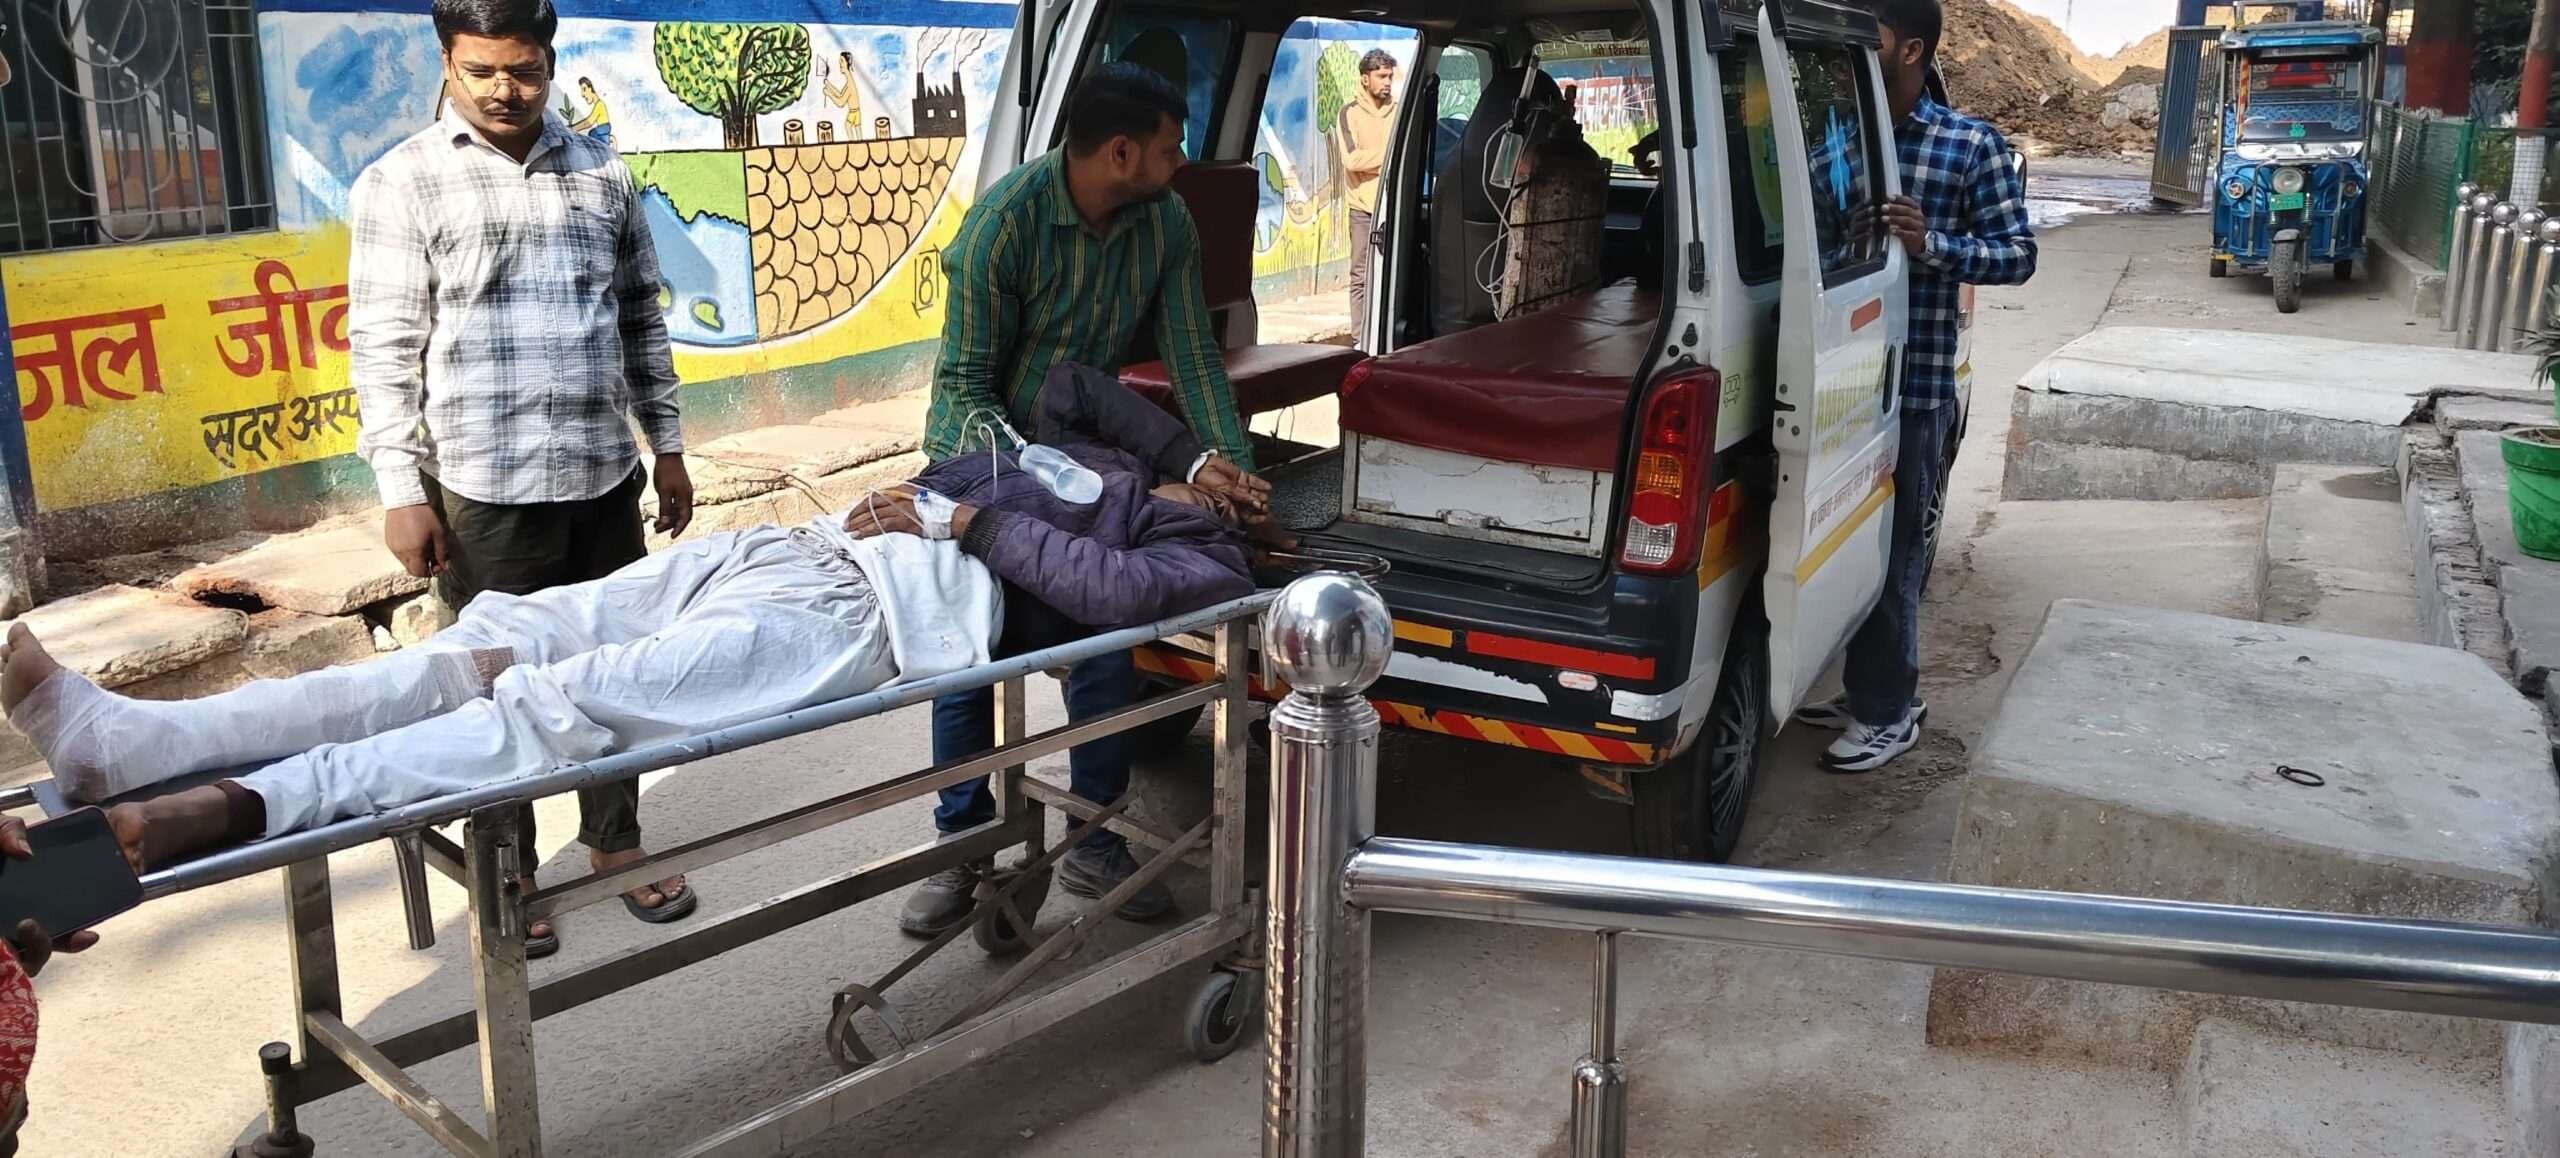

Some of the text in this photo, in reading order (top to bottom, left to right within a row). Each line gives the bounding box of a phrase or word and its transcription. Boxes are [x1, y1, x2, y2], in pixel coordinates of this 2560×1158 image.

[208, 260, 351, 378] जीव
[200, 387, 364, 469] सदर अस्प
